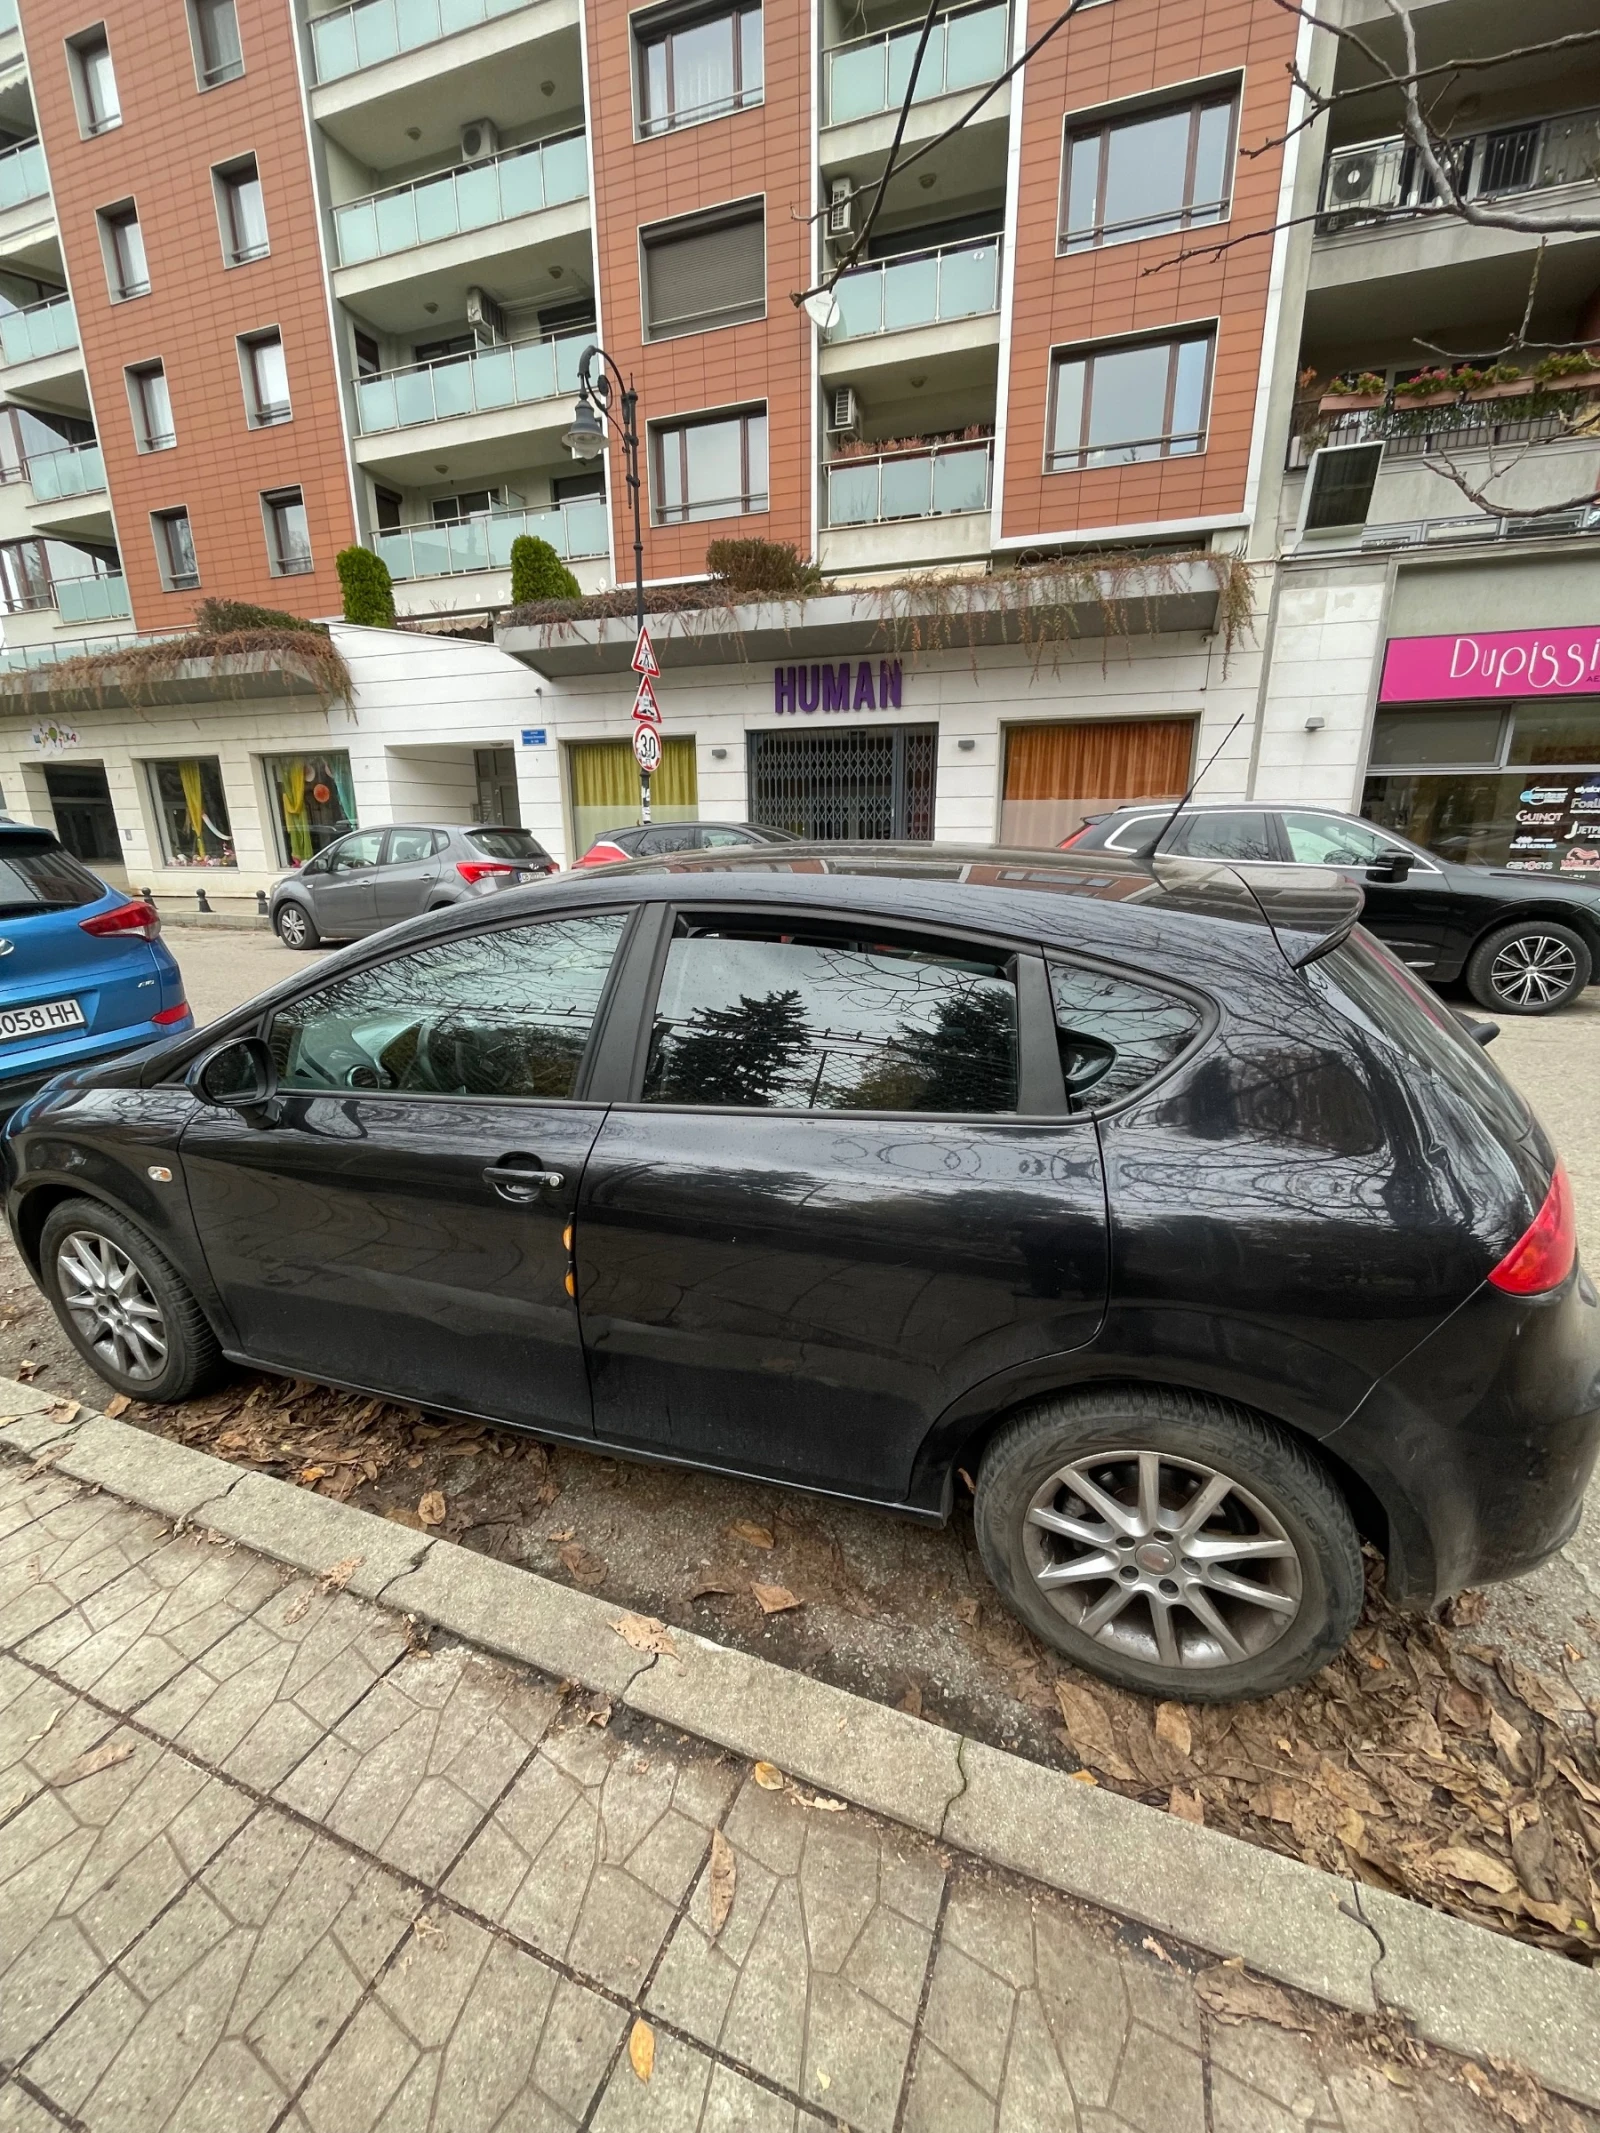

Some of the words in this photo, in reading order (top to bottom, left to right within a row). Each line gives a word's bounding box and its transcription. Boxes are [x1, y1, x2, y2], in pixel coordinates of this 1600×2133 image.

[774, 659, 902, 714] HUMAN
[641, 734, 656, 759] 30
[0, 1009, 46, 1035] 058
[45, 1002, 80, 1026] HH
